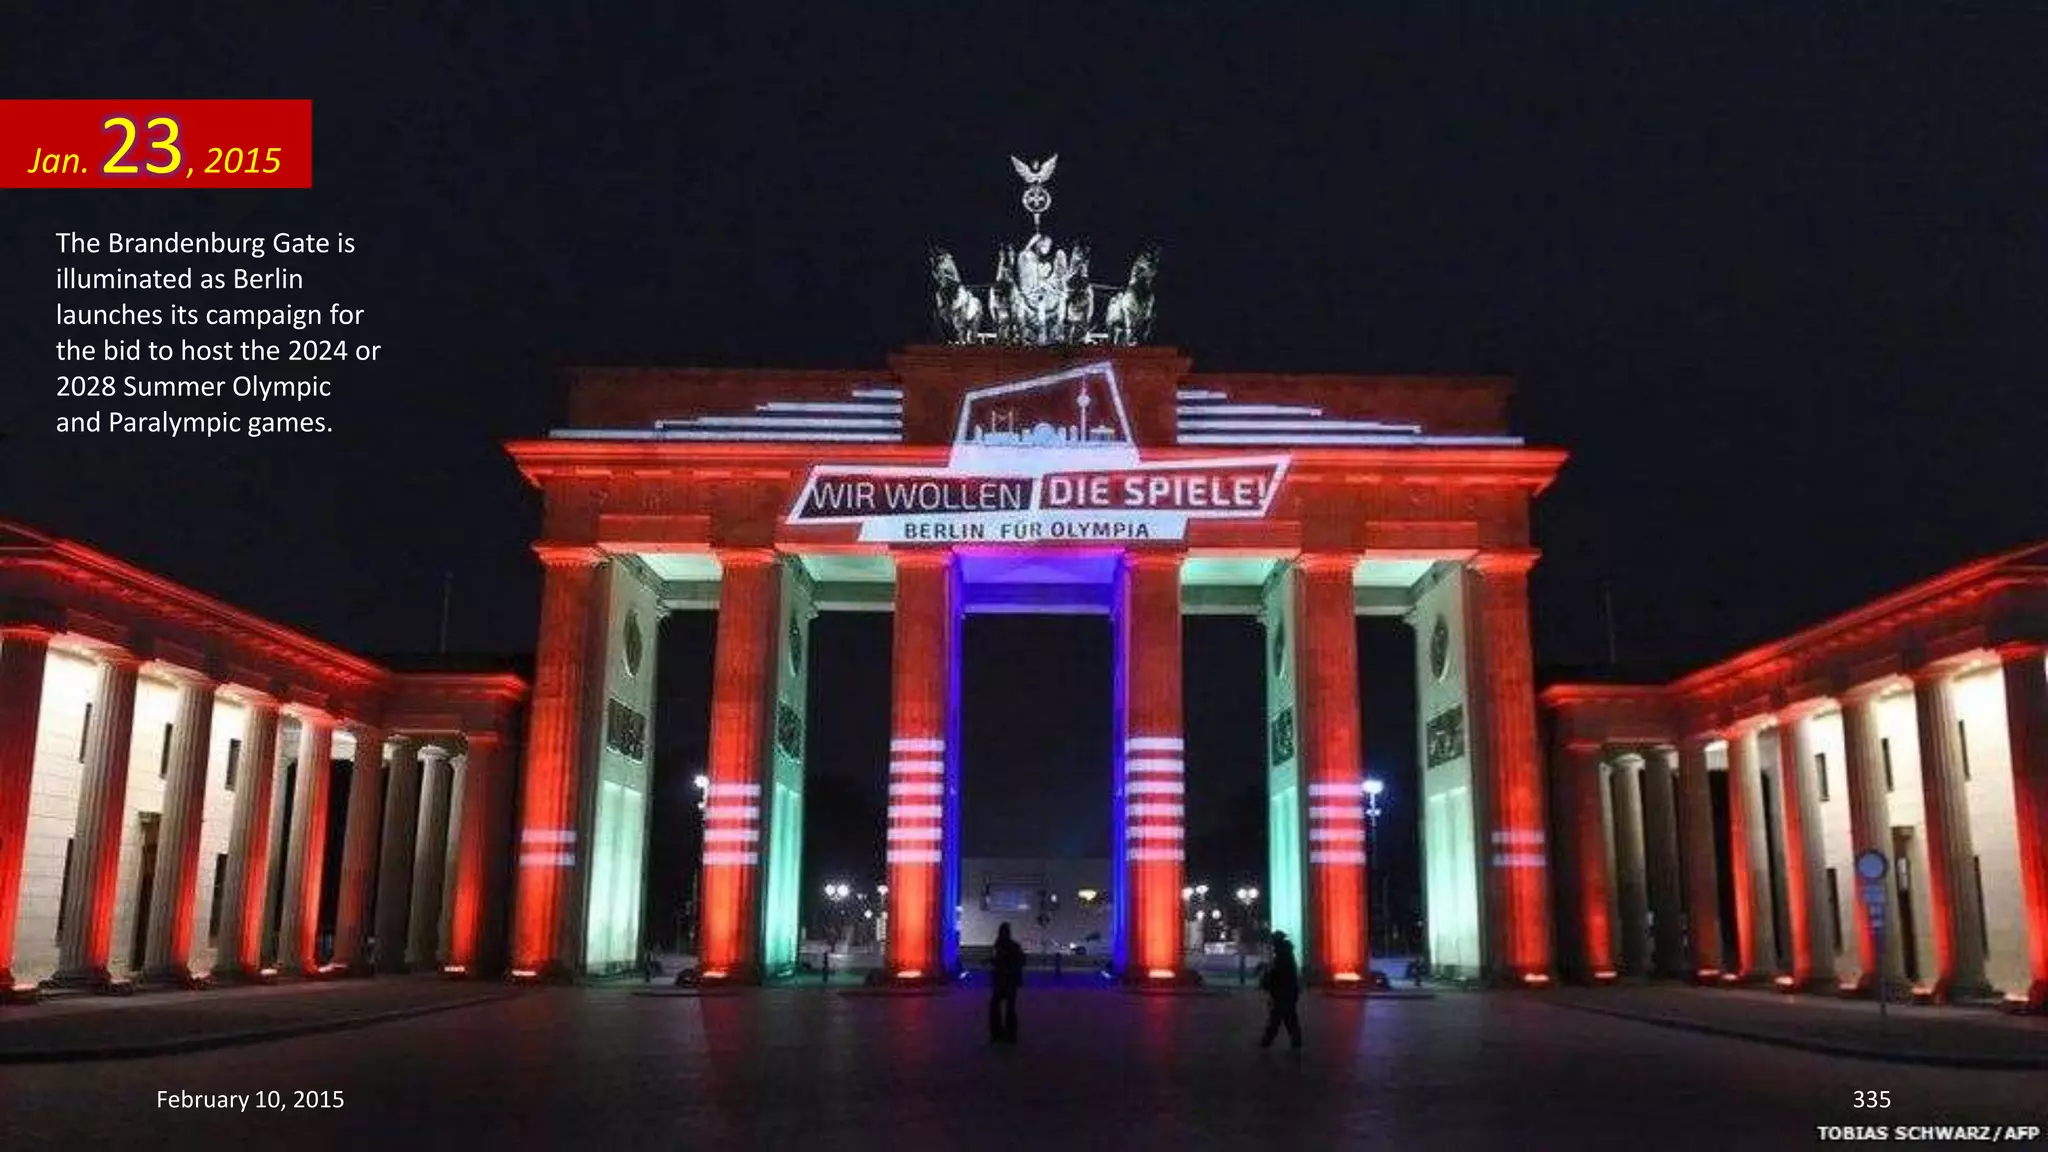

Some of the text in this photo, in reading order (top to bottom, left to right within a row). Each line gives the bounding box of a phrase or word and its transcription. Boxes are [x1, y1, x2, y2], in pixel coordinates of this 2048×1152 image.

[810, 475, 1267, 510] WIR WOLLEN DIE SPIELE!
[903, 522, 985, 539] BERLIN
[1050, 520, 1150, 538] OLYMPIA
